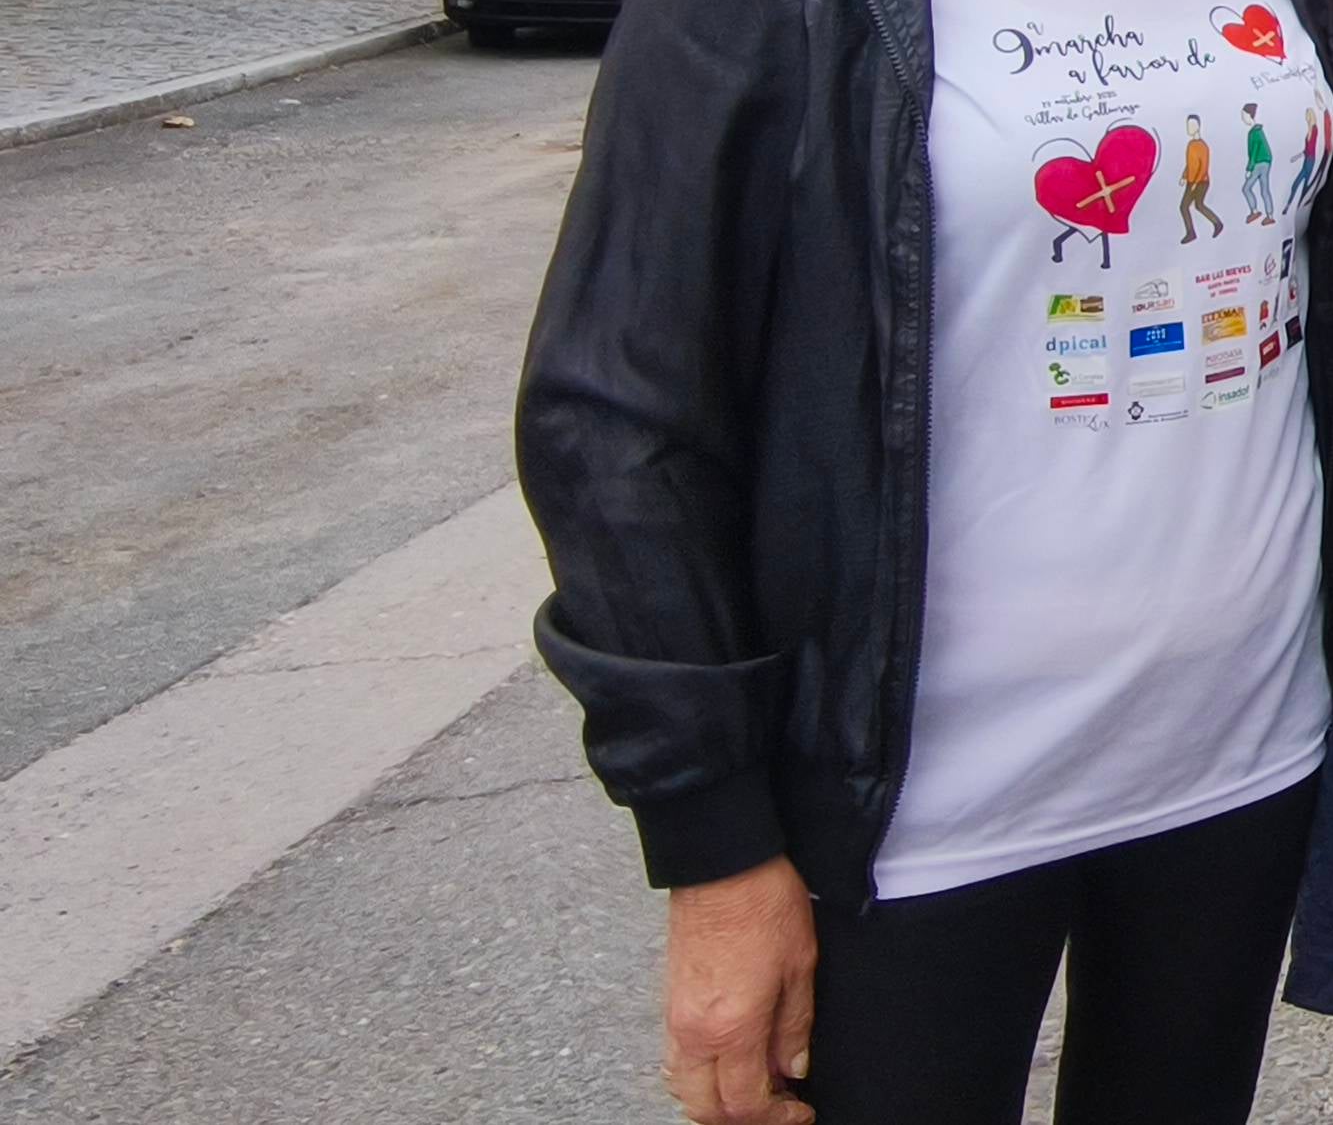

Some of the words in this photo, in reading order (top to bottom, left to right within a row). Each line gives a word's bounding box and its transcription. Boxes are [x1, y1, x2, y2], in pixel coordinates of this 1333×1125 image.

[1035, 14, 1144, 57] marcha
[1068, 69, 1086, 84] a
[1092, 50, 1179, 86] favor
[1186, 38, 1215, 69] de
[1045, 334, 1108, 356] dpical
